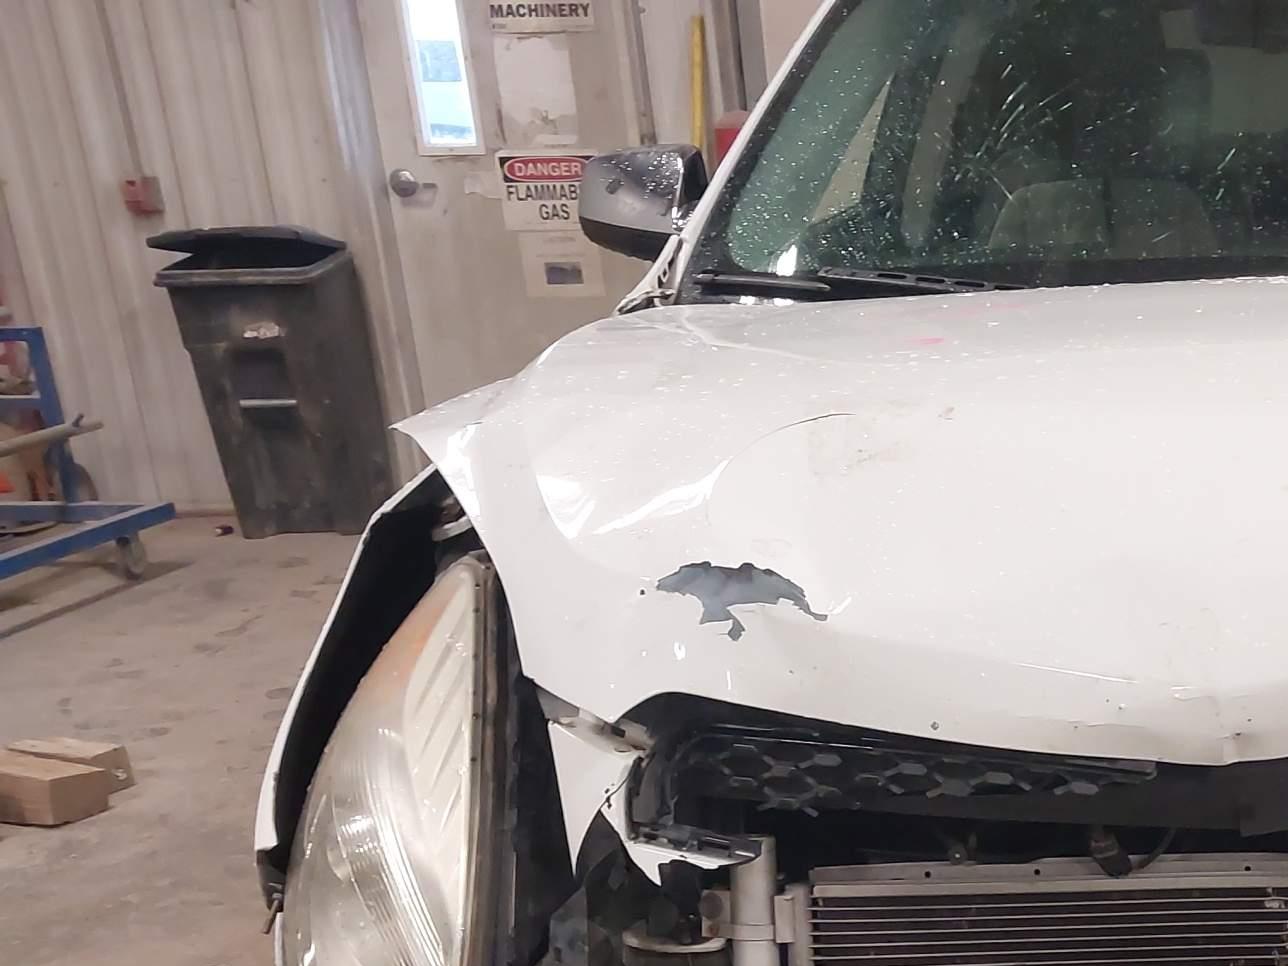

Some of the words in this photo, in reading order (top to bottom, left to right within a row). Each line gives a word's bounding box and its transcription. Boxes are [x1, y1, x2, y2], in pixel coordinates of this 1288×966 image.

[489, 3, 590, 18] MACHINERY
[513, 162, 582, 176] DANGER
[506, 184, 579, 201] FLAMMAB
[539, 203, 570, 220] GAS
